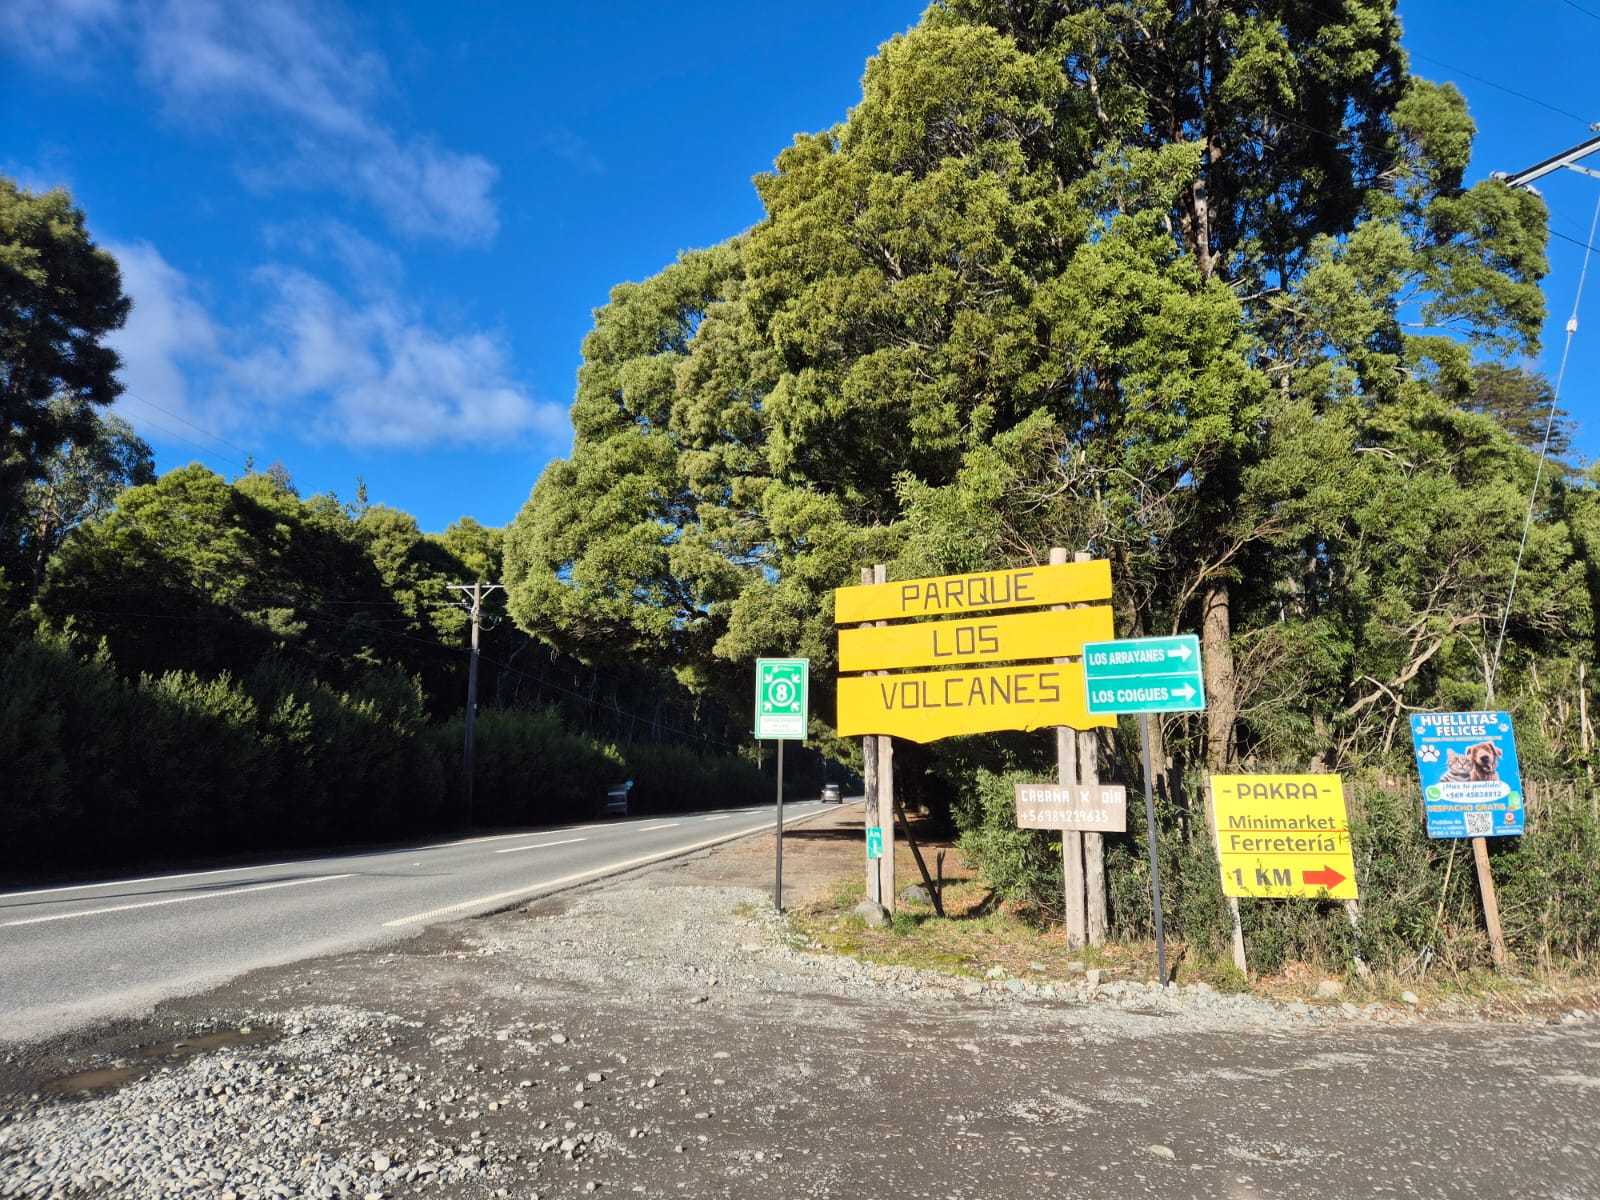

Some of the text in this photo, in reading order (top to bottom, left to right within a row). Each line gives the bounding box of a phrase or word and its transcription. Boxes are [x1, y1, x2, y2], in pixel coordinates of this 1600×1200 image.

[901, 572, 1035, 611] PARQUE
[932, 625, 999, 657] LOS
[1089, 649, 1166, 666] LOS ARRAYANES
[775, 684, 788, 701] 8
[881, 672, 1060, 710] VOLCANES
[1092, 687, 1169, 703] LOS COIGUES
[1421, 714, 1498, 726] HUELLITAS
[1436, 725, 1487, 736] FELICES
[1237, 782, 1318, 800] PAKRA
[1228, 813, 1336, 829] Minimarket
[1230, 833, 1336, 851] Ferretería
[1232, 867, 1292, 887] 1 KM
